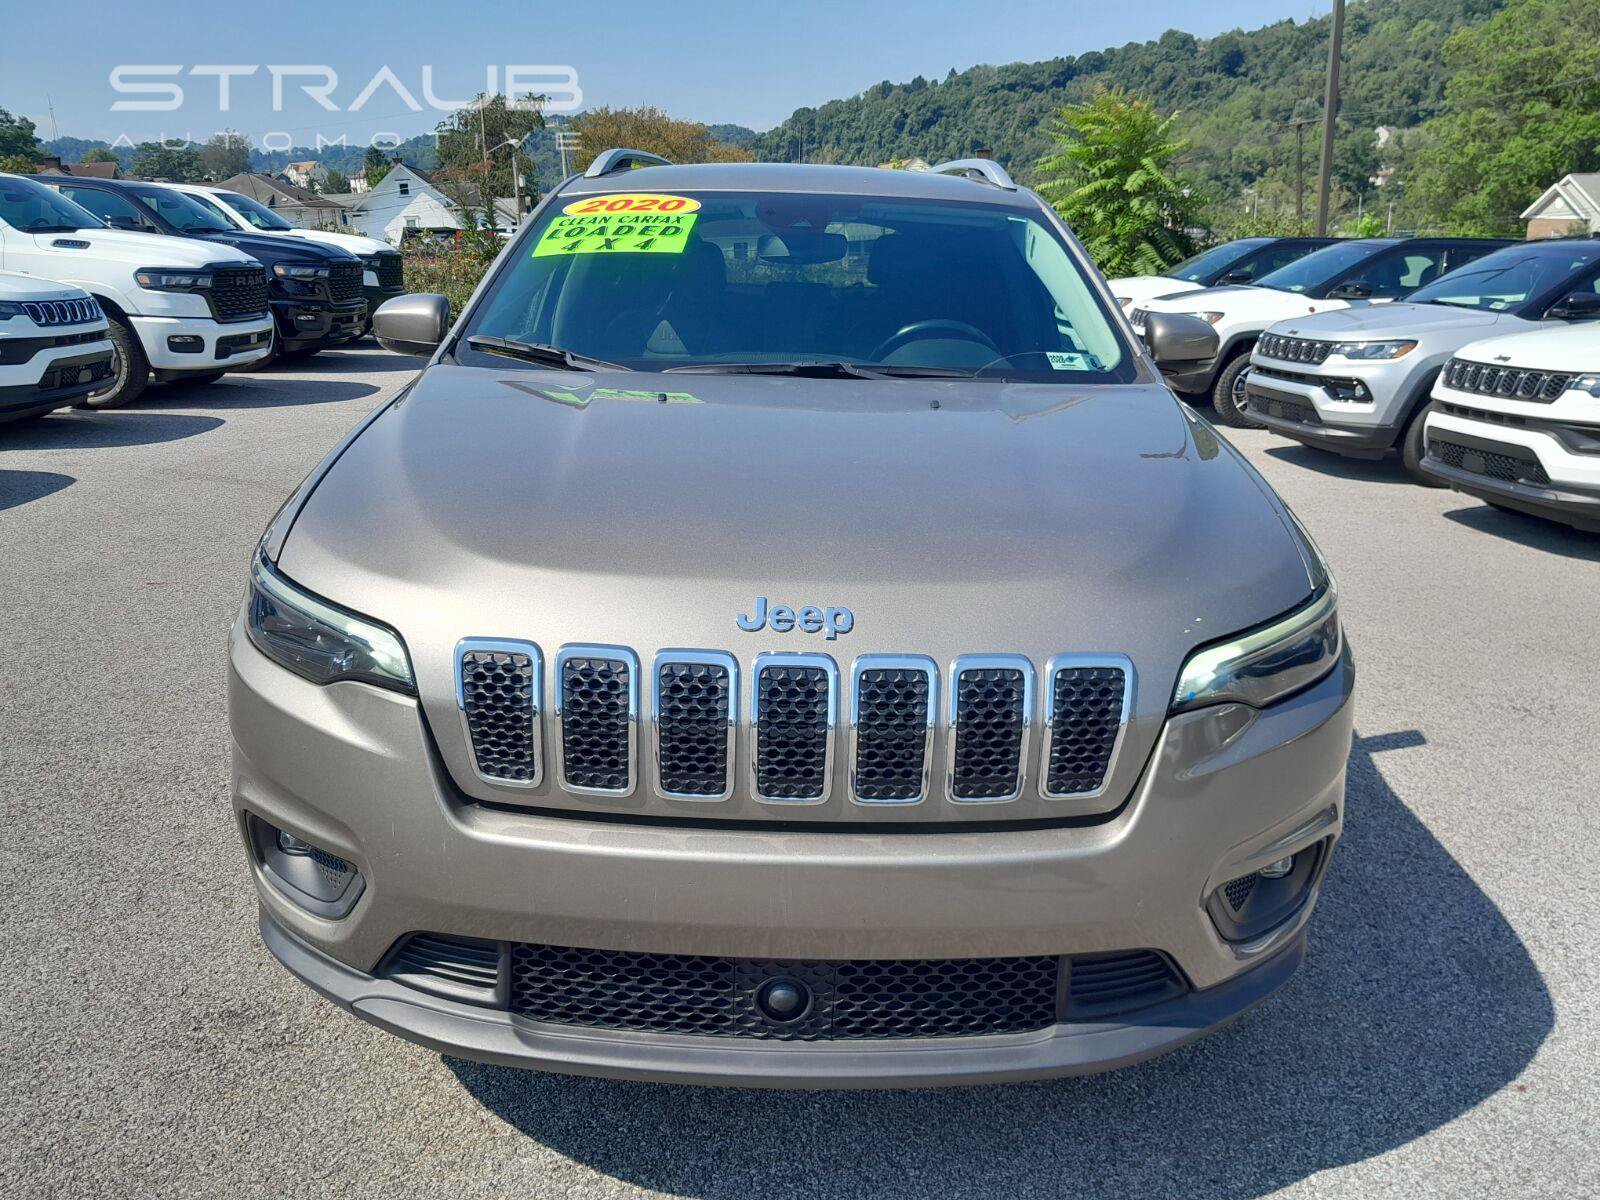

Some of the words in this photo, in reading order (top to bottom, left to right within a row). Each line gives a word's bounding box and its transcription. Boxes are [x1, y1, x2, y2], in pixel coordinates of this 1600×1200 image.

[577, 199, 686, 213] 2020
[558, 215, 612, 227] CLEAN
[617, 214, 686, 224] CARFAX
[546, 225, 683, 240] LOADED
[561, 239, 584, 252] 4
[634, 237, 657, 251] 4
[735, 596, 854, 640] Jeep
